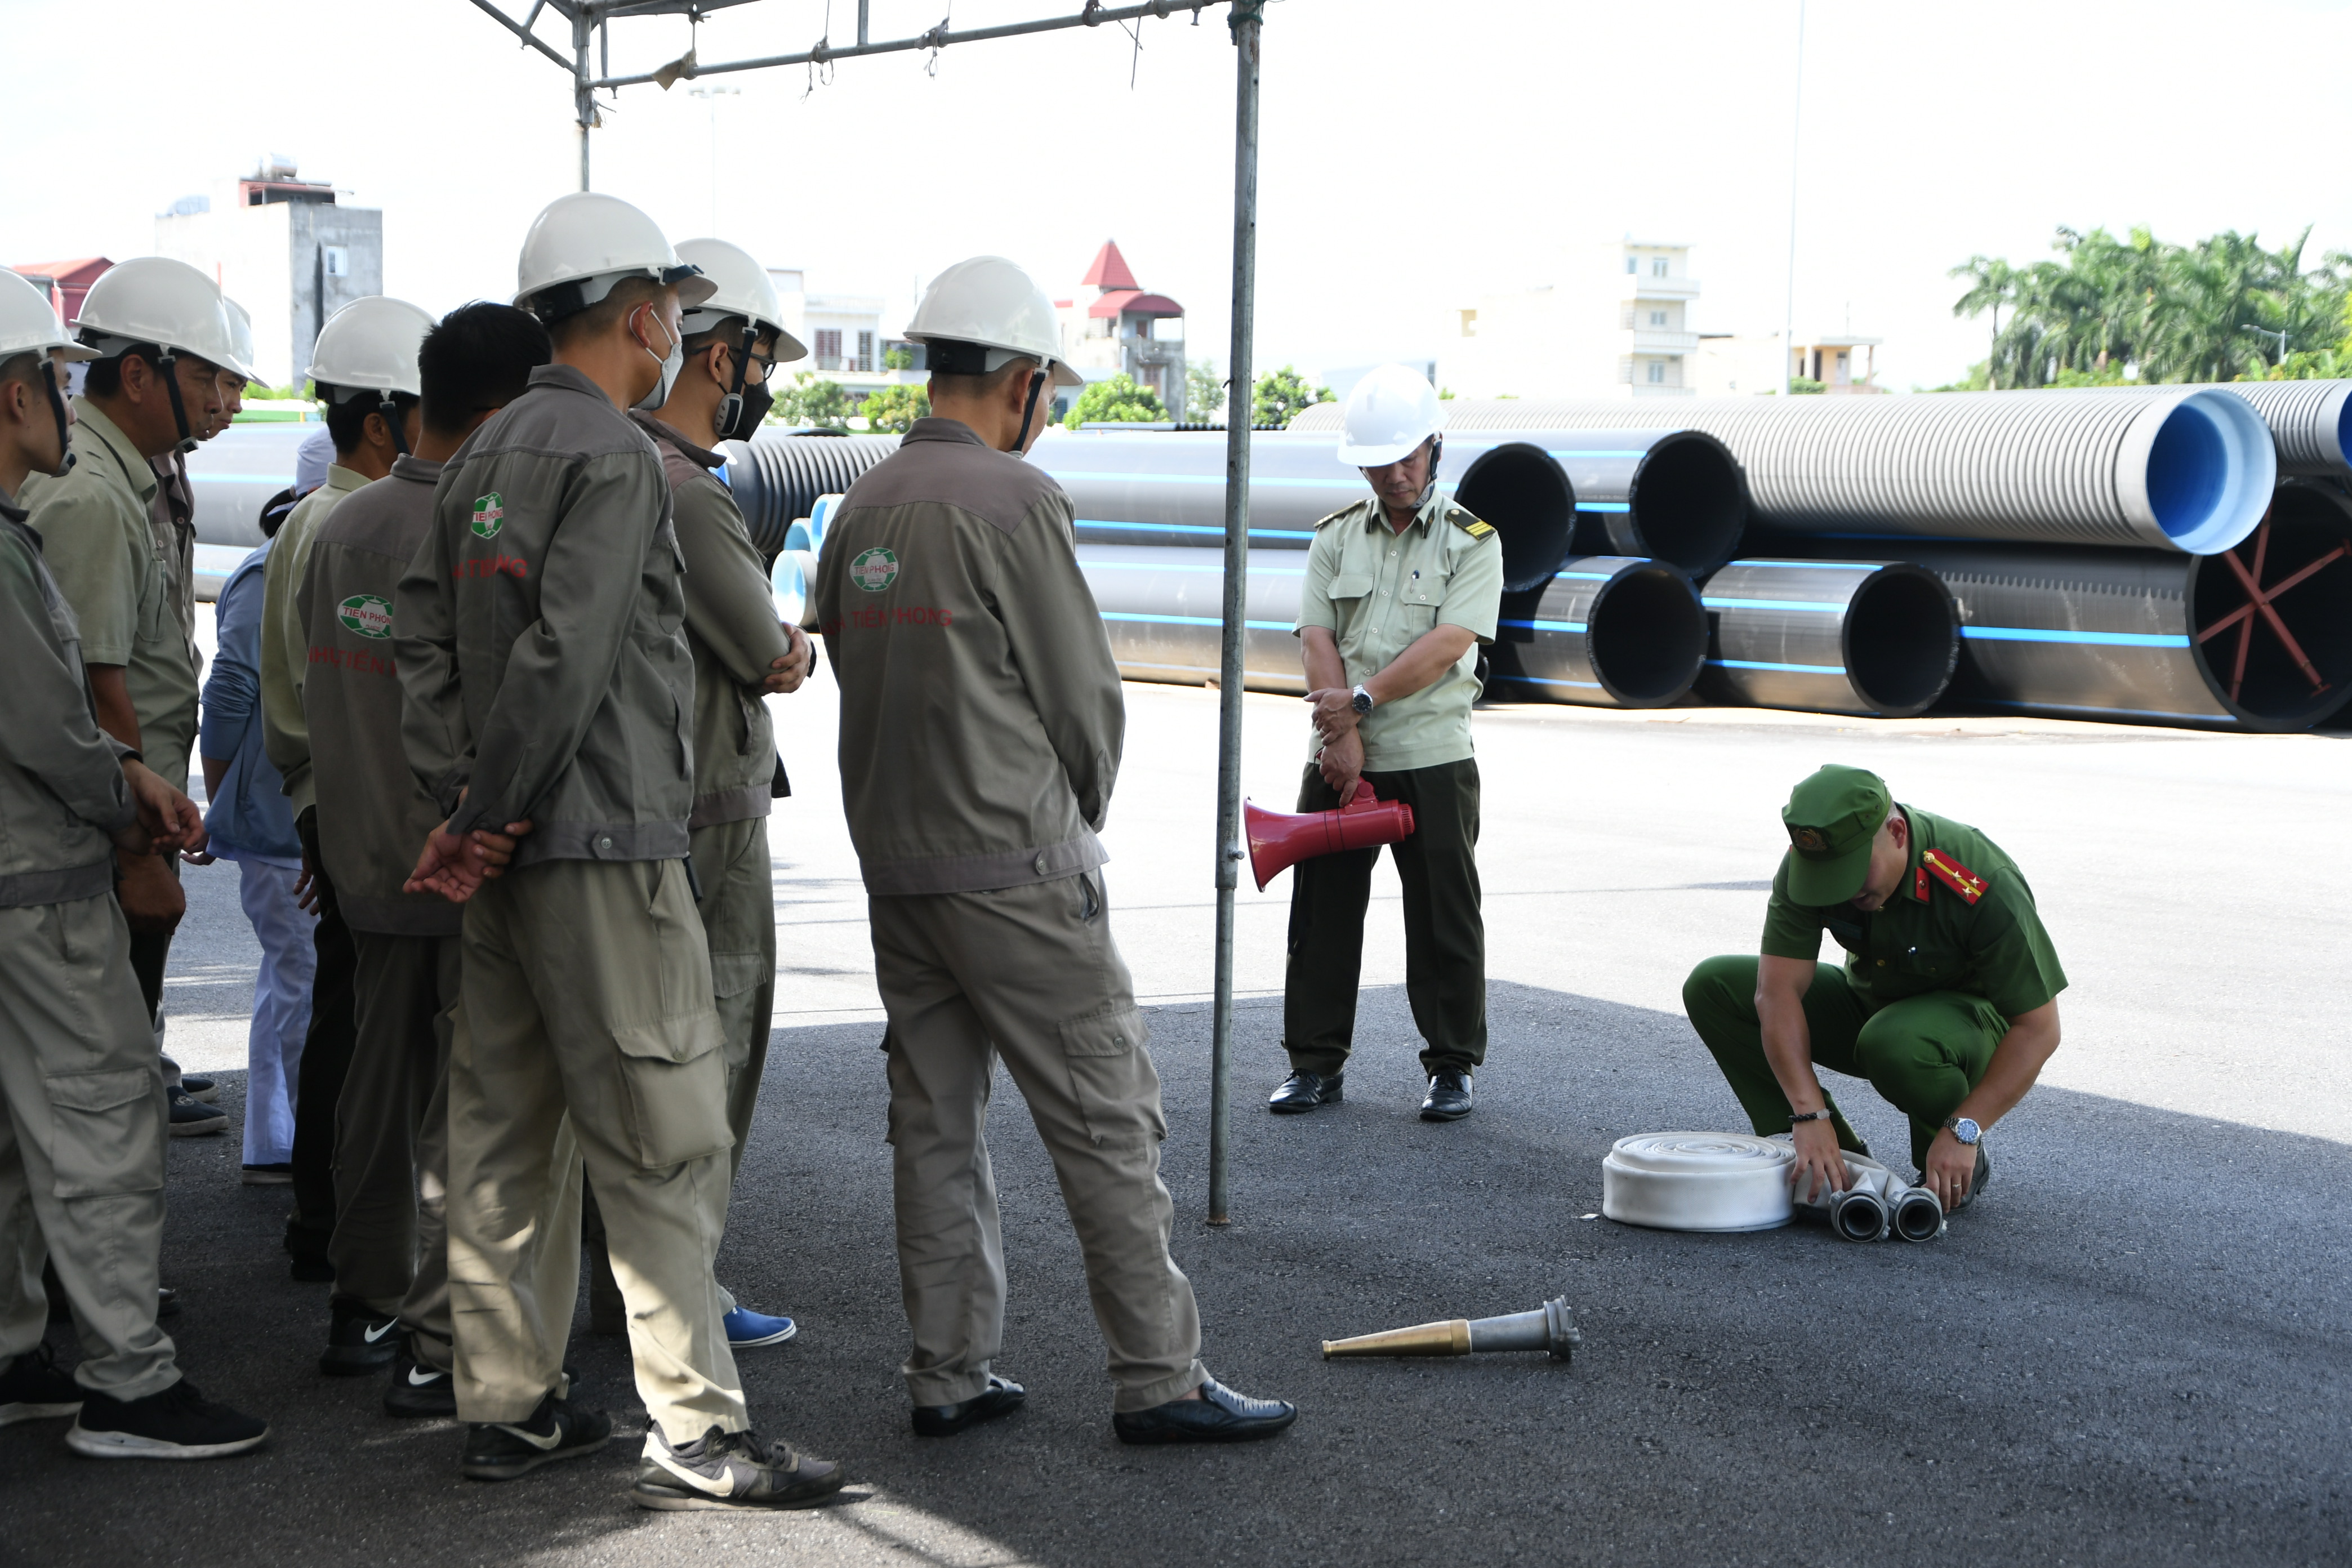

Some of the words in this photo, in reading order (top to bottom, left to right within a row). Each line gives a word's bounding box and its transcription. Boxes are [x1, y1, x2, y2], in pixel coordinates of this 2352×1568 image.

[854, 566, 868, 574] TIEN
[343, 607, 367, 619] TIEN
[369, 612, 391, 625] PHON
